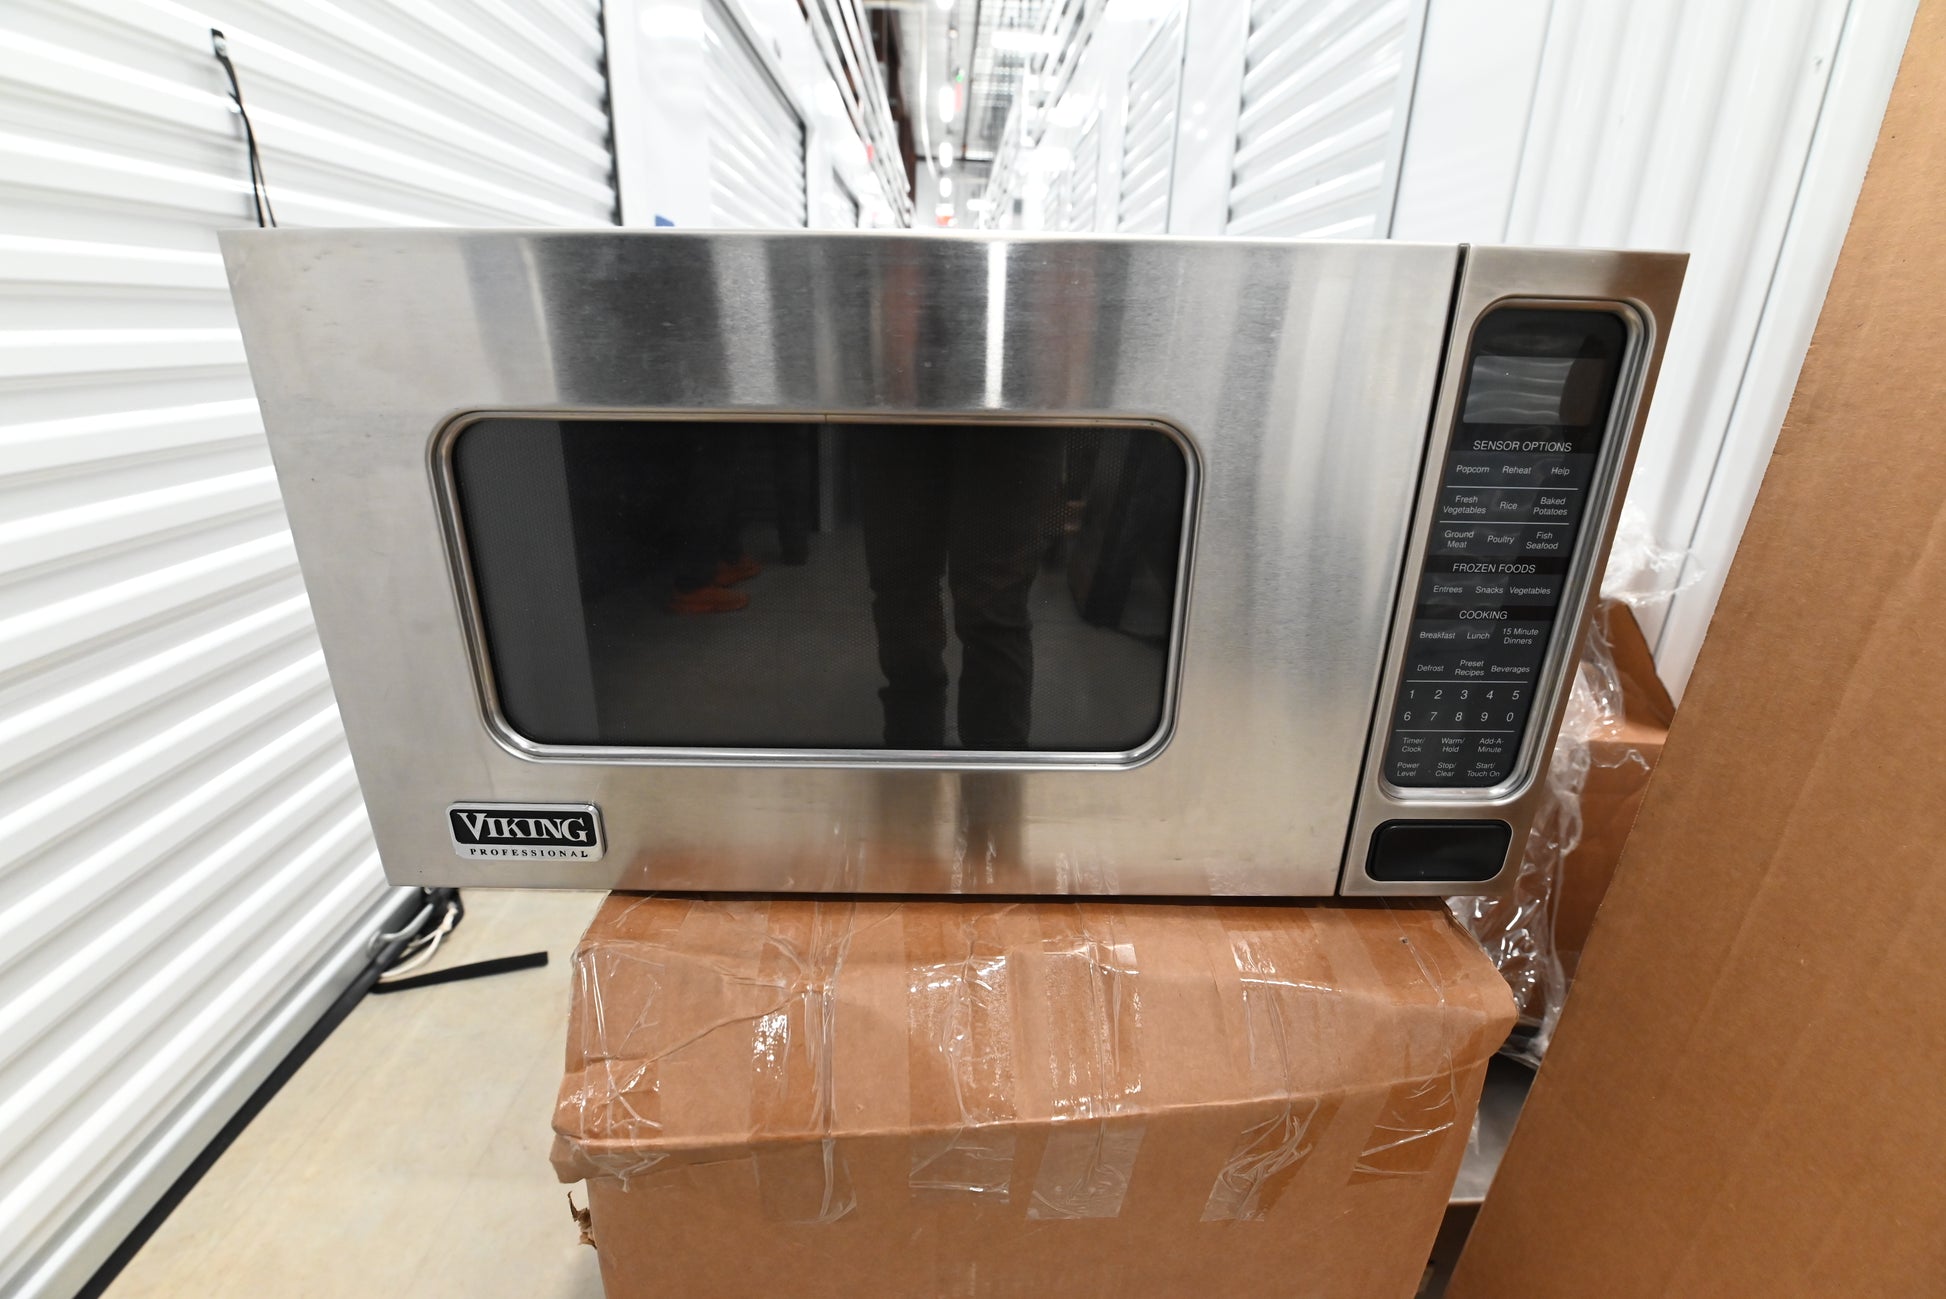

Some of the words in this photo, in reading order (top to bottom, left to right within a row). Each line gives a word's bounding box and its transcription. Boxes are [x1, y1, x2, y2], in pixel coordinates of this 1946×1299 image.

[1473, 440, 1520, 451] SENSOR
[1522, 441, 1572, 452] OPTIONS
[1456, 465, 1490, 474] Popcorn
[1502, 466, 1532, 474] Reheat
[1551, 467, 1570, 476] Help
[1455, 495, 1478, 503] Fresh
[1540, 497, 1566, 505] Baked
[1443, 506, 1486, 515] Vegetables
[1500, 502, 1517, 510] Rice
[1533, 507, 1568, 516] Potatoes
[1444, 530, 1474, 538] Ground
[1447, 540, 1467, 548] Meat
[1487, 535, 1515, 544] Poultry
[1526, 541, 1559, 550] Seafood
[1453, 563, 1496, 573] FROZEN
[1499, 564, 1535, 574] FOODS
[1433, 585, 1463, 593] Entrees
[1475, 586, 1503, 594] Snacks
[1509, 586, 1551, 595] Vegetables
[1459, 611, 1508, 620] COOKING
[1420, 631, 1456, 639] Breakfast
[1467, 632, 1490, 640] Lunch
[1514, 628, 1539, 636] Minute
[1503, 637, 1532, 645] Dinners
[1417, 664, 1444, 672] Defrost
[1455, 668, 1484, 677] Recipes
[1491, 665, 1530, 674] Beverages
[1410, 690, 1414, 698] 1
[1434, 690, 1442, 699] 2
[1460, 690, 1468, 699] 3
[1486, 690, 1494, 699] 4
[1512, 691, 1520, 699] 5
[1404, 712, 1411, 721] 6
[1430, 712, 1437, 721] 7
[1455, 712, 1463, 721] 8
[1480, 712, 1488, 721] 9
[1506, 712, 1514, 722] 0
[1402, 745, 1422, 753] Clock
[1442, 745, 1459, 753] Hold
[457, 812, 588, 842] VIKING
[470, 848, 588, 858] PROFESSIONAL
